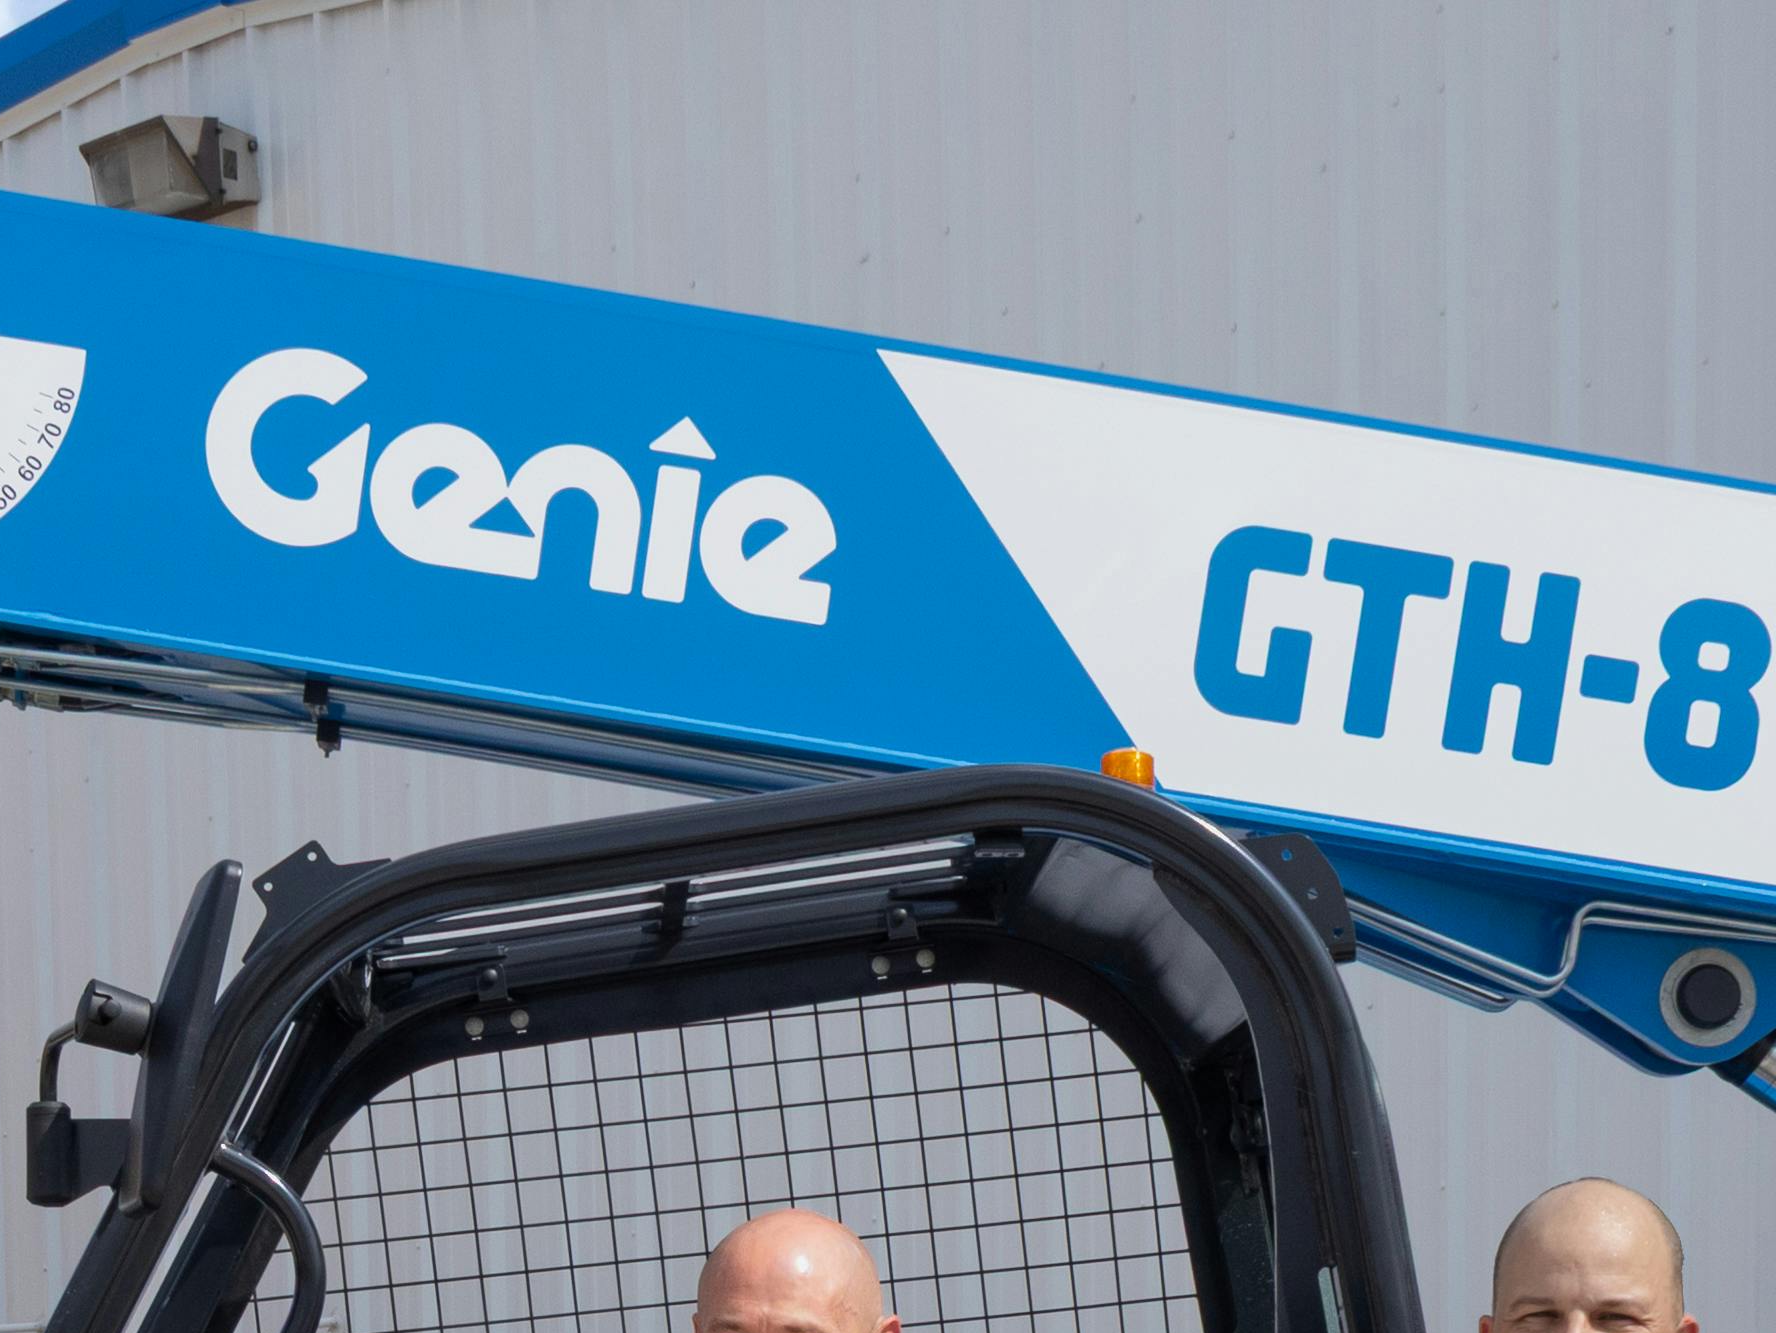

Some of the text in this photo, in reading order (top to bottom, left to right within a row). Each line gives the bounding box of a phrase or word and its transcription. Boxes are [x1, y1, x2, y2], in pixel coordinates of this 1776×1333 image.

[17, 454, 44, 483] 60
[37, 422, 63, 450] 70
[52, 386, 77, 415] 80
[205, 348, 837, 626] Genie
